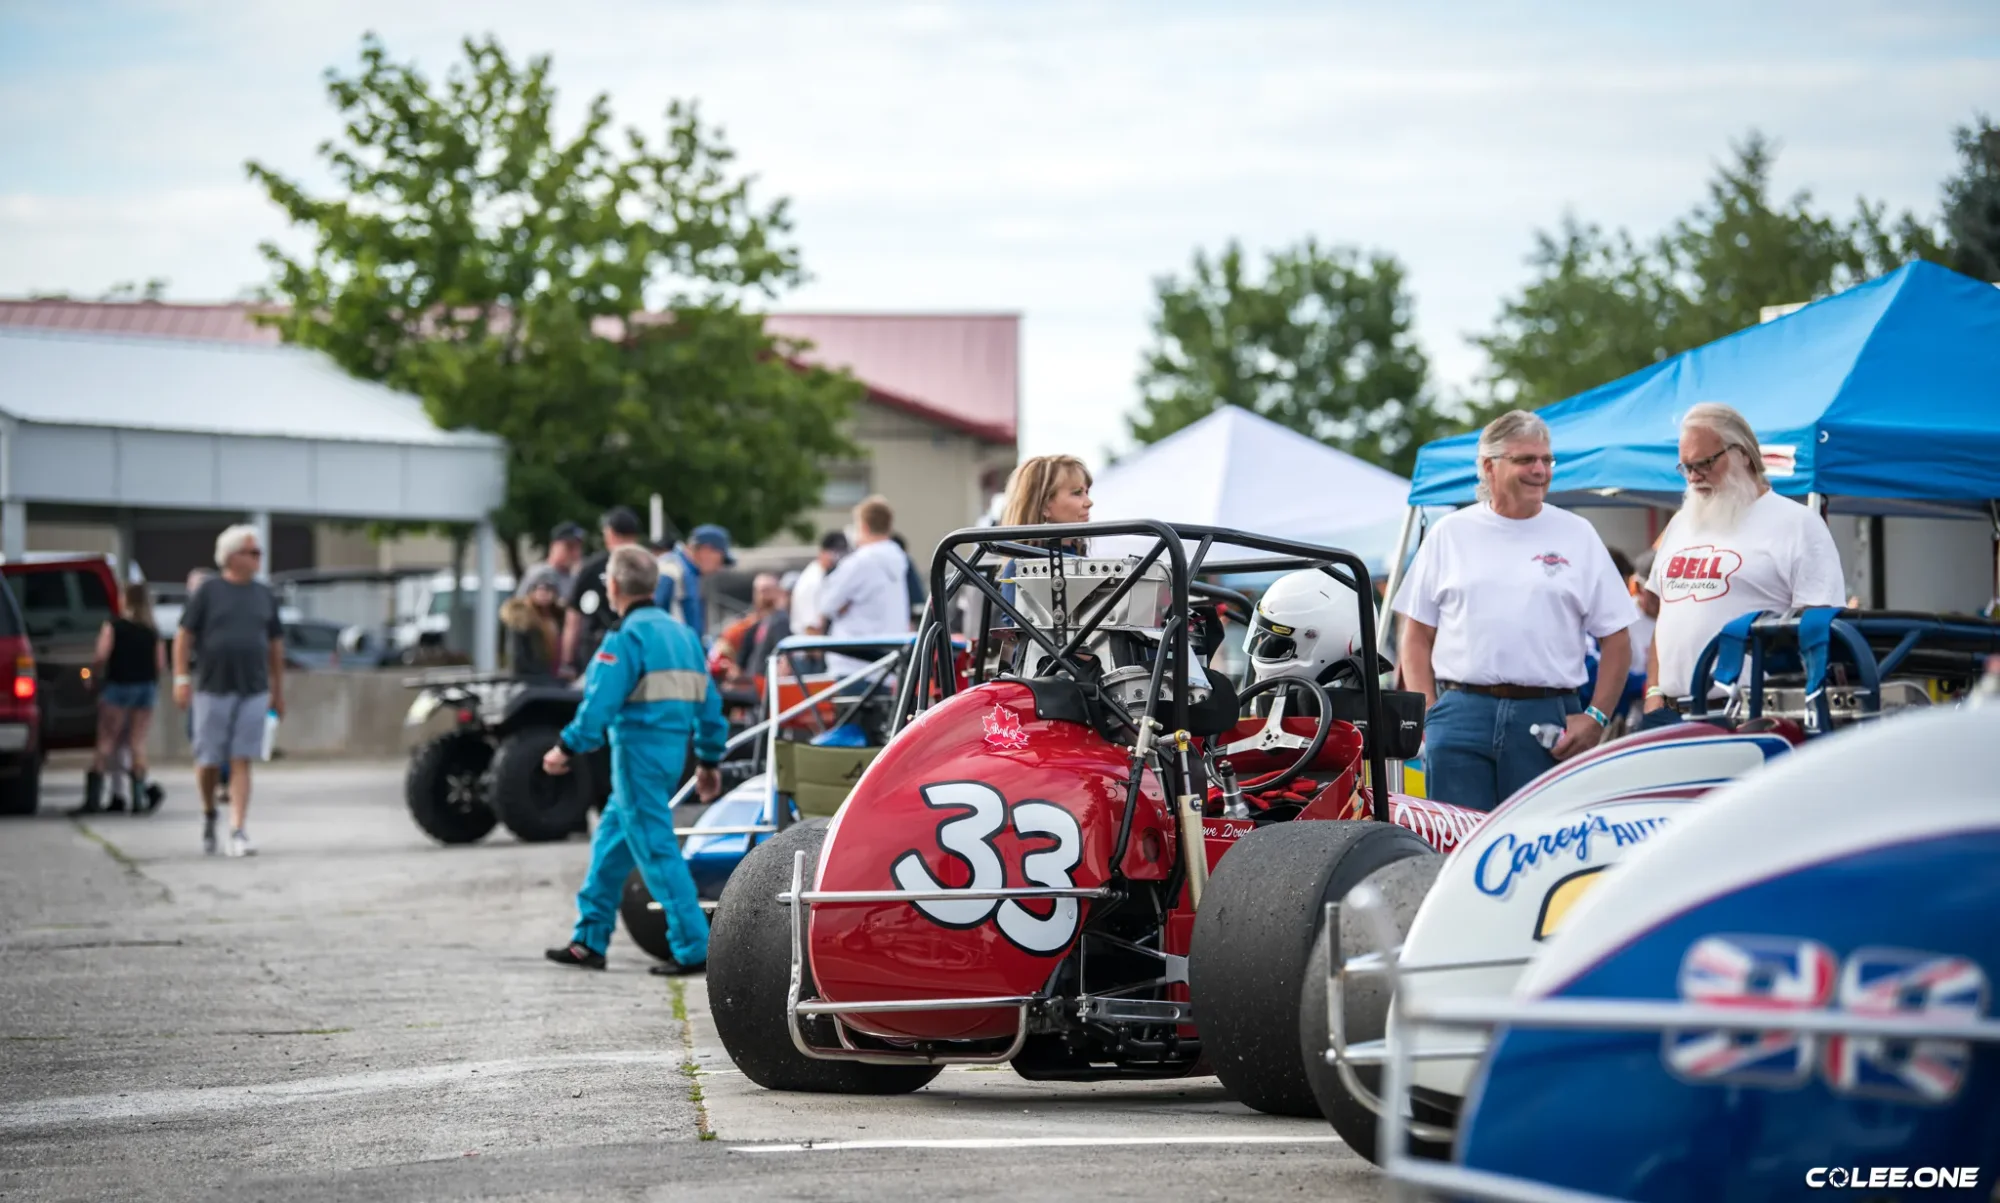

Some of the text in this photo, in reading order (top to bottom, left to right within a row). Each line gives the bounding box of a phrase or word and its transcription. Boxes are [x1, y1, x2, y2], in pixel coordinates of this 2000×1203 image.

[1666, 556, 1722, 579] BELL
[890, 779, 1084, 958] 33
[1474, 813, 1671, 897] Carey's AUT
